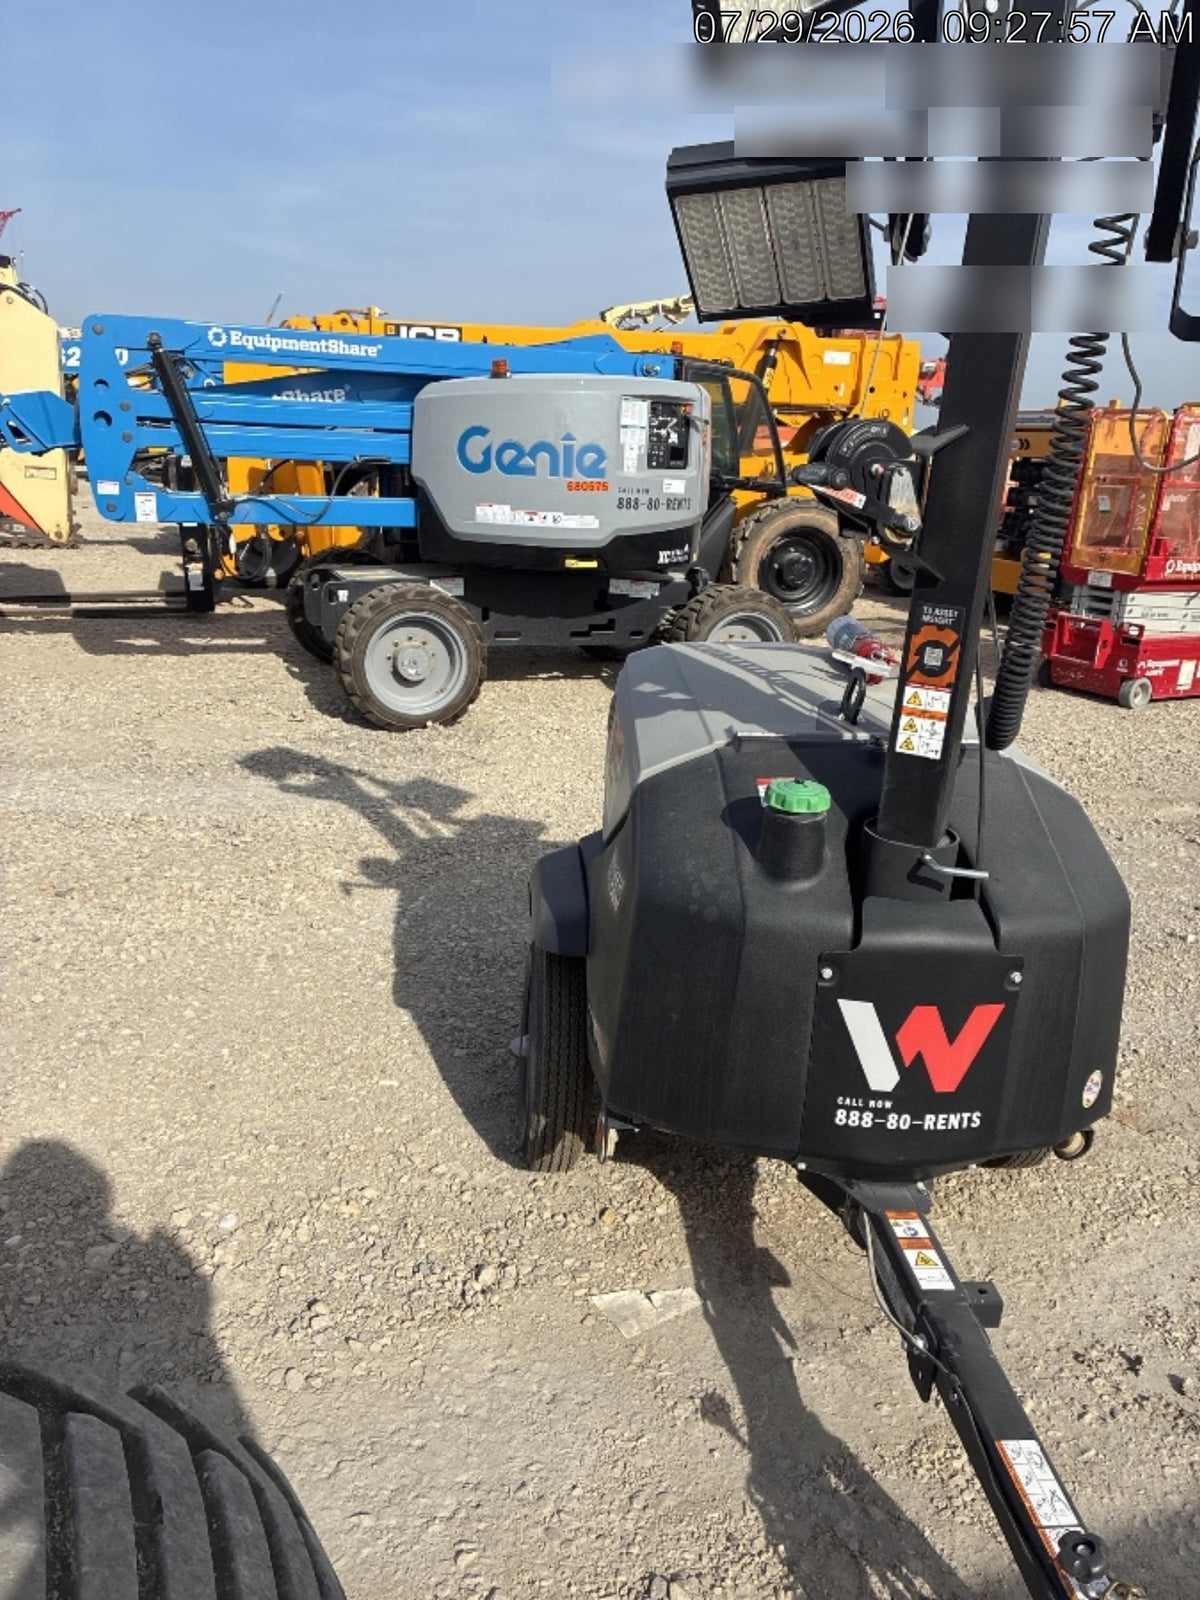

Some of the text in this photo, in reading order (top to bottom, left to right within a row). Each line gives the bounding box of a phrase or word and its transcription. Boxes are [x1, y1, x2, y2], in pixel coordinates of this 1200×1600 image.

[230, 330, 378, 357] EquipmentShare
[456, 425, 607, 479] Genie
[836, 1096, 893, 1109] CALL NOW
[834, 1108, 982, 1131] 888-80-RENTS
